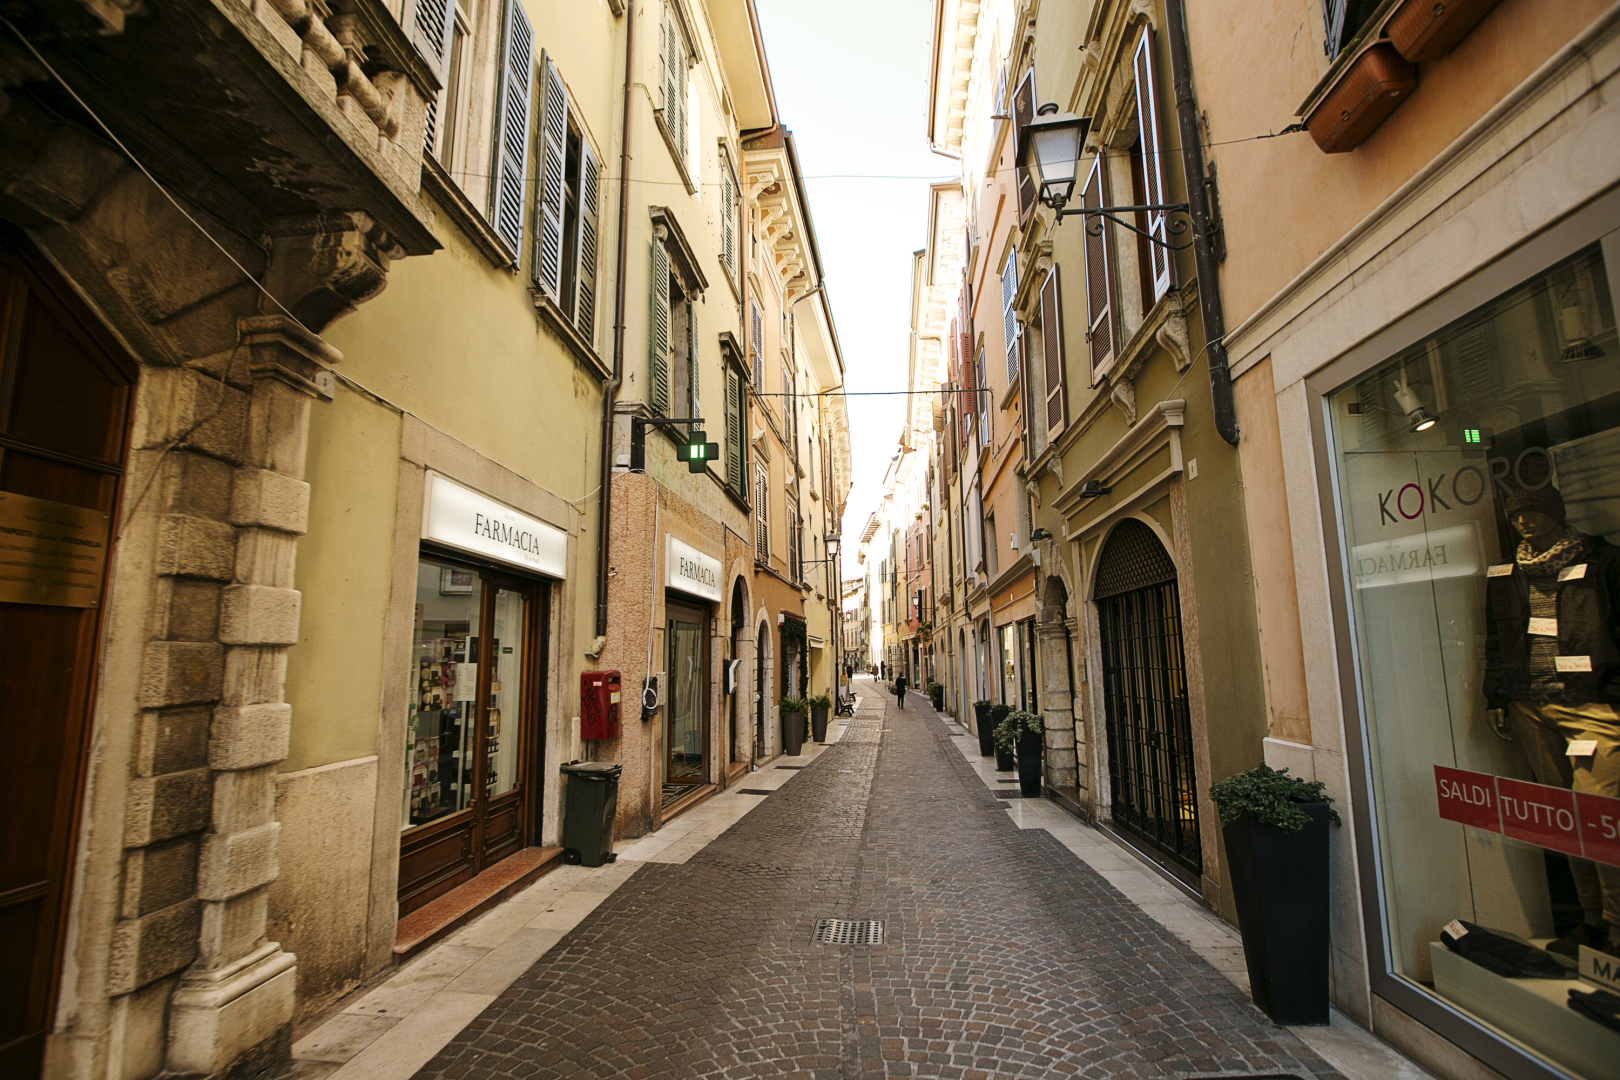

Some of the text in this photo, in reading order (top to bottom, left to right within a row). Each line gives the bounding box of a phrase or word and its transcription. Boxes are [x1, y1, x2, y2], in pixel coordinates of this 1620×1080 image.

[1378, 446, 1554, 526] KOKORO
[474, 512, 540, 555] FARMACIA
[679, 556, 716, 588] FARMACIA
[1439, 778, 1620, 839] SALDI TUTTO -5
